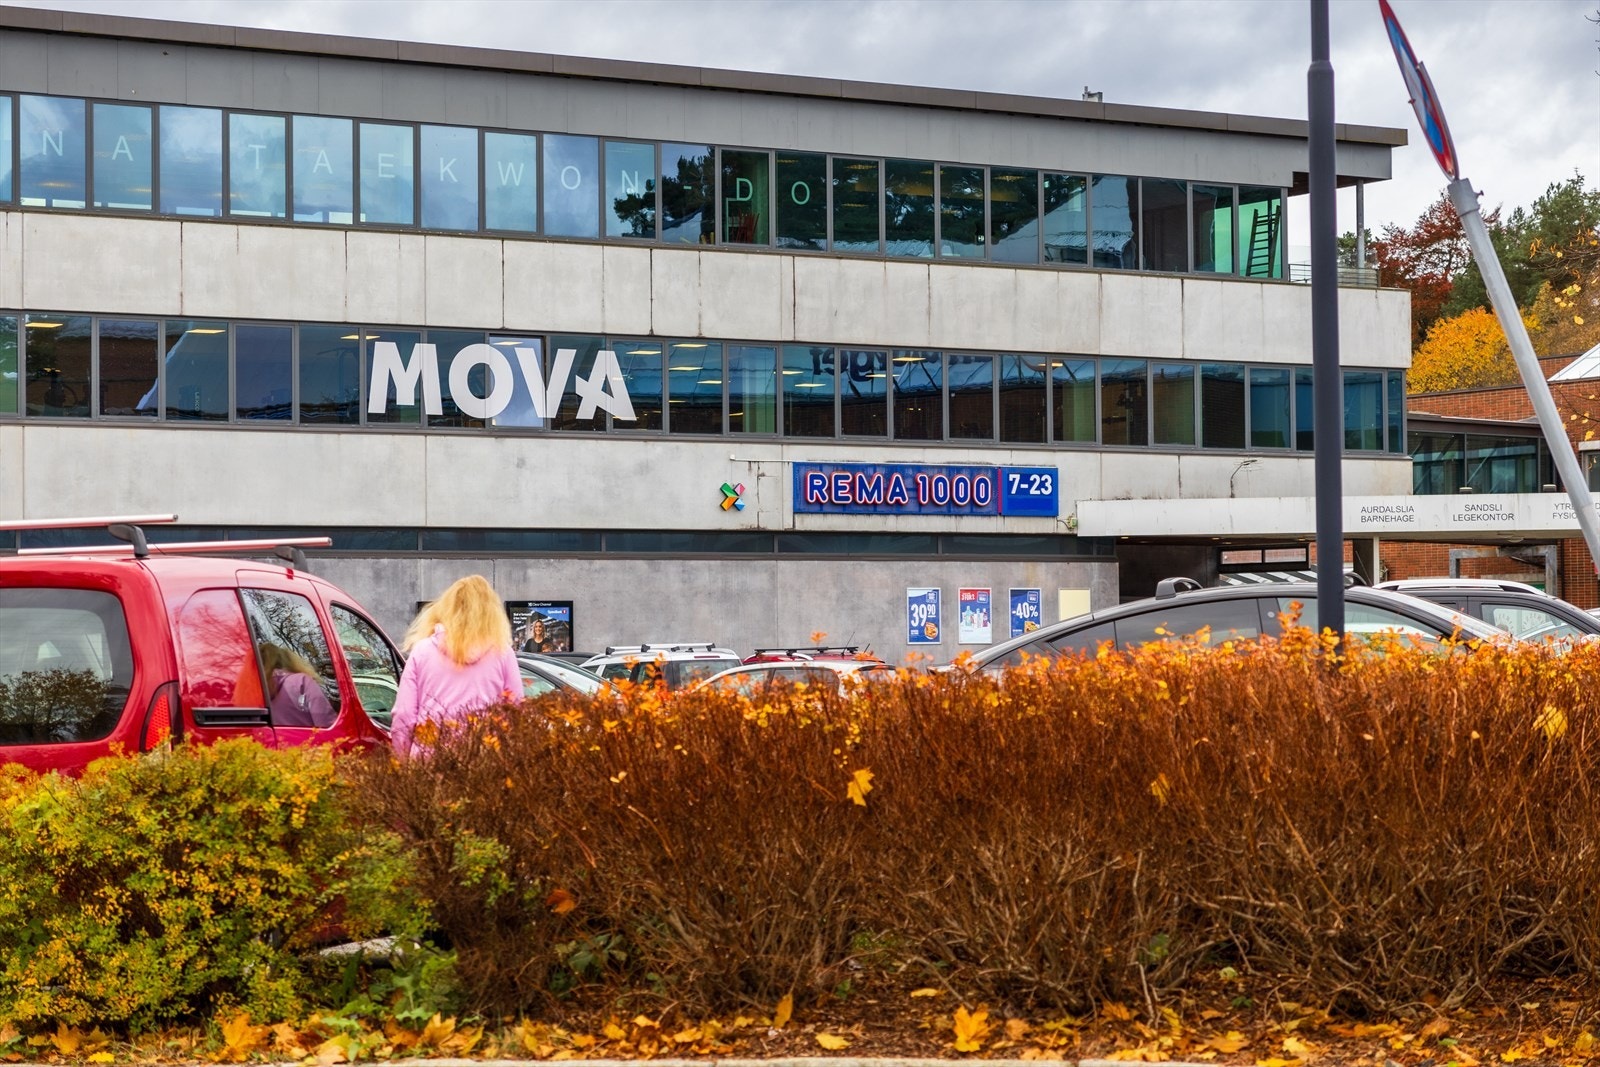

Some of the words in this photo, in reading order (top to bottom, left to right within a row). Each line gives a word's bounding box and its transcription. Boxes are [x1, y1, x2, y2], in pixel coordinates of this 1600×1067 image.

[367, 341, 638, 421] MOVA
[806, 471, 909, 505] REMA
[916, 472, 992, 506] 1000
[1008, 473, 1053, 496] 7-23
[1361, 505, 1415, 514] AURDALSLIA
[1464, 503, 1503, 512] SANDSLI
[1361, 514, 1415, 523] BARNEHAGE
[1453, 513, 1515, 522] LEGEKONTOR
[1011, 602, 1039, 619] -40%
